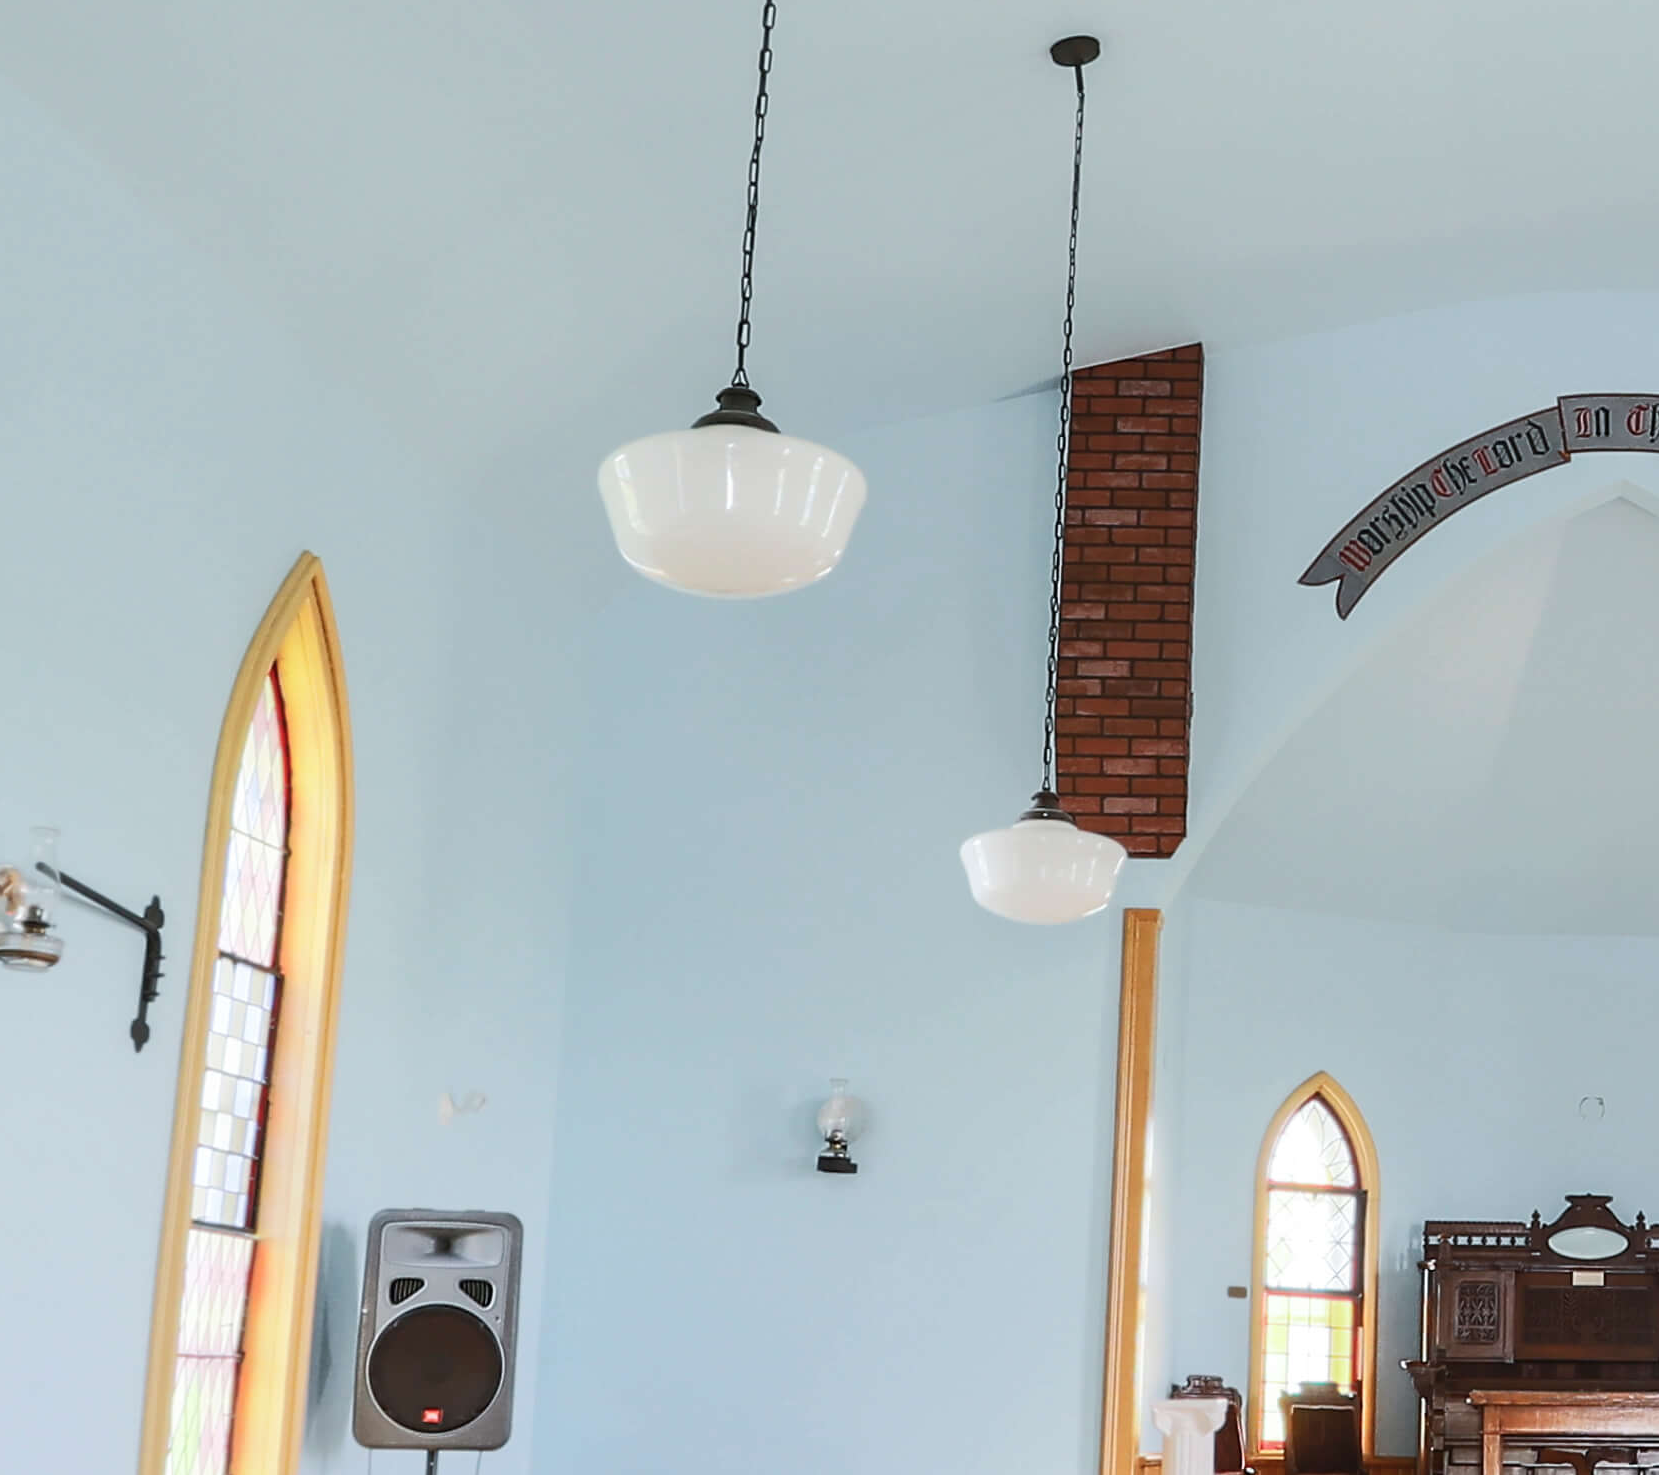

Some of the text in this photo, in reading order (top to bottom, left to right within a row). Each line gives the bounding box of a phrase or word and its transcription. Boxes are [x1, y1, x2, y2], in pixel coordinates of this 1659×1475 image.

[1339, 483, 1437, 572] Worship
[1430, 457, 1477, 498] The
[1472, 421, 1549, 476] Lord
[1573, 406, 1610, 438] In
